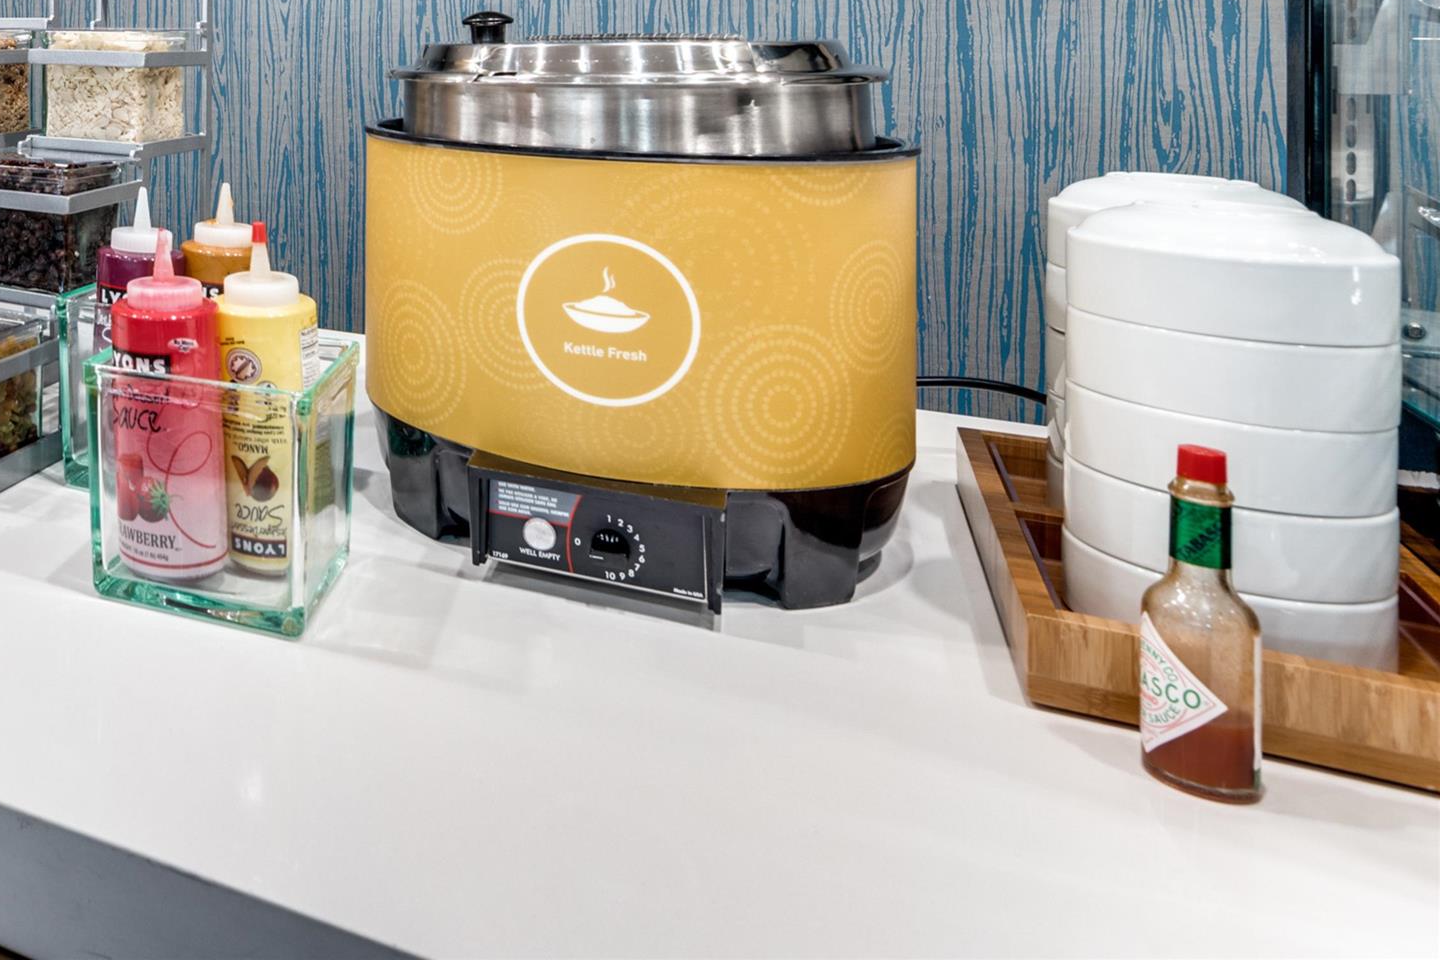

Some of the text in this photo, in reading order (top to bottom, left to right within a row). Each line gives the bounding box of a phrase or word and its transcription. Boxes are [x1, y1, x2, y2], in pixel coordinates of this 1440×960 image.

[563, 341, 647, 363] Kettle Fresh
[112, 350, 166, 374] YONS
[238, 443, 268, 454] MANGO
[235, 503, 286, 527] Sauce
[606, 514, 612, 523] 1
[617, 518, 624, 527] 2
[627, 524, 633, 533] 3
[574, 537, 581, 546] 0
[633, 534, 640, 542] 4
[234, 537, 285, 556] LYONS
[639, 544, 646, 553] 5
[519, 547, 561, 561] WELL EMPTY
[638, 555, 646, 563] 6
[634, 563, 640, 572] 7
[605, 571, 616, 581] 10
[619, 572, 626, 581] 9
[628, 569, 635, 578] 8
[1149, 705, 1181, 724] SAUCE
